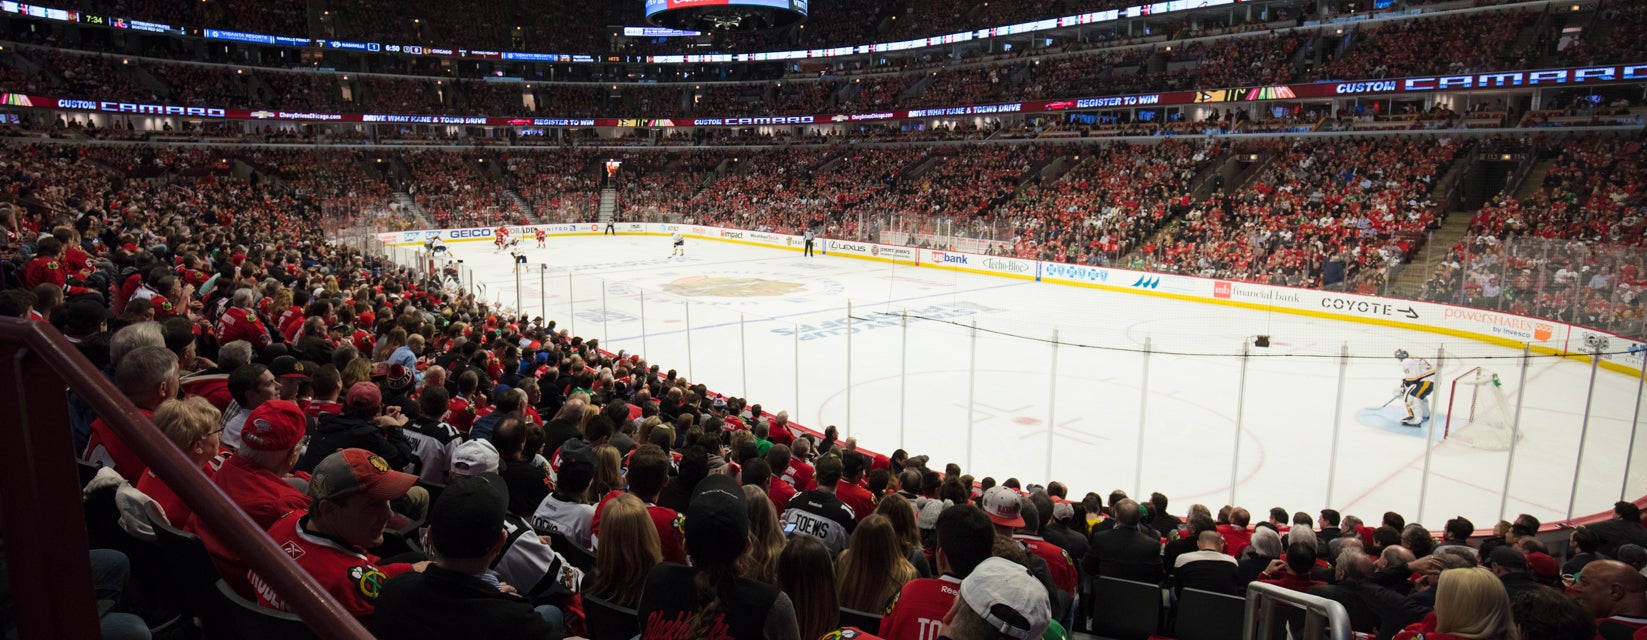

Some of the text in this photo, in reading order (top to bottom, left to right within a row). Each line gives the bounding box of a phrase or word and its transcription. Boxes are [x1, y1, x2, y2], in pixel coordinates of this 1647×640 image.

[86, 15, 102, 24] 7:34
[1336, 81, 1396, 93] CUSTOM
[1077, 94, 1159, 108] REGISTER TO WIN
[58, 99, 225, 117] CUSTOM CAMARO
[999, 104, 1021, 112] DRIVE
[279, 112, 341, 120] ChevyDrivesChicago.com
[725, 116, 814, 125] CAMARO
[450, 229, 491, 238] GEICO
[725, 231, 743, 239] impact
[989, 259, 1024, 272] Techo-Bloc
[1215, 285, 1300, 303] mb financial bank
[1322, 297, 1392, 316] COYOTE
[796, 514, 829, 538] TOEWS
